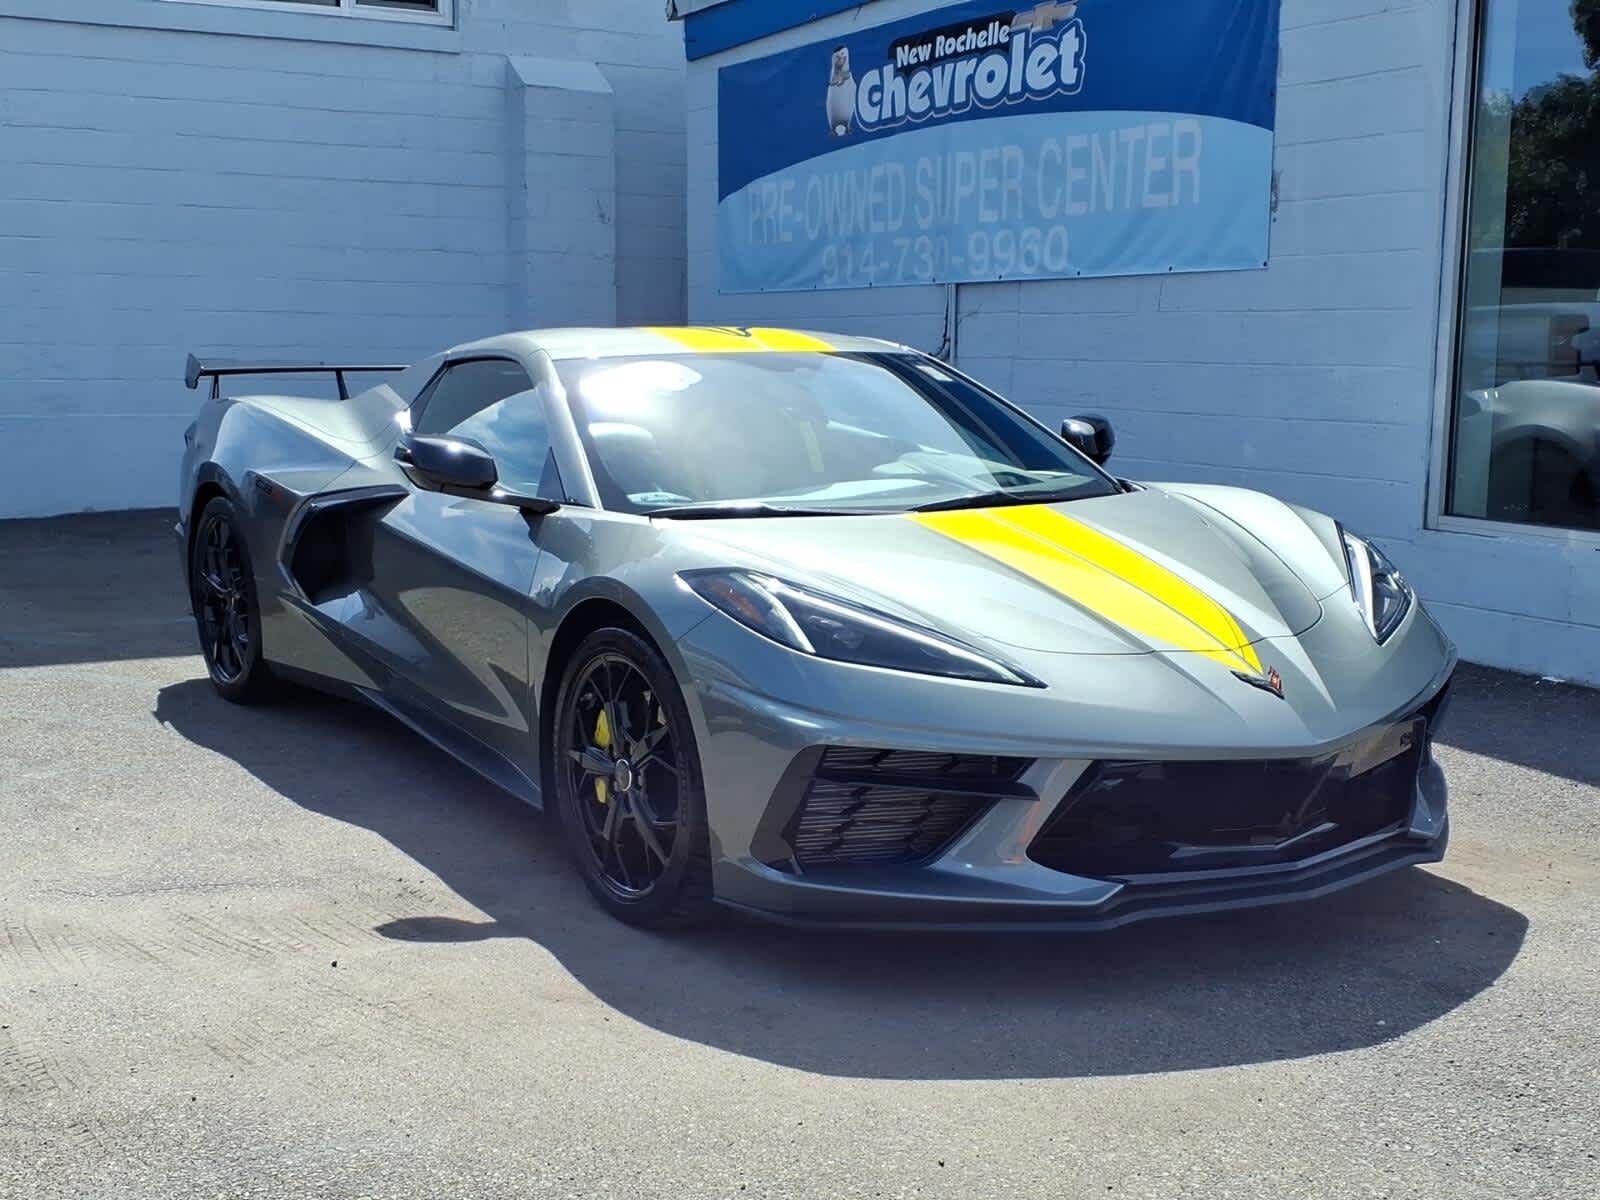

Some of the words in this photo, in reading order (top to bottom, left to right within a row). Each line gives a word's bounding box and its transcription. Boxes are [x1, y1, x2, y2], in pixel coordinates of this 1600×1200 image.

[857, 26, 1081, 123] Chevrolet
[896, 43, 932, 68] New
[935, 21, 1010, 58] Rochelle
[749, 164, 906, 244] PRE-OWNED
[914, 144, 1024, 231] SUPER
[1037, 119, 1202, 219] CENTER
